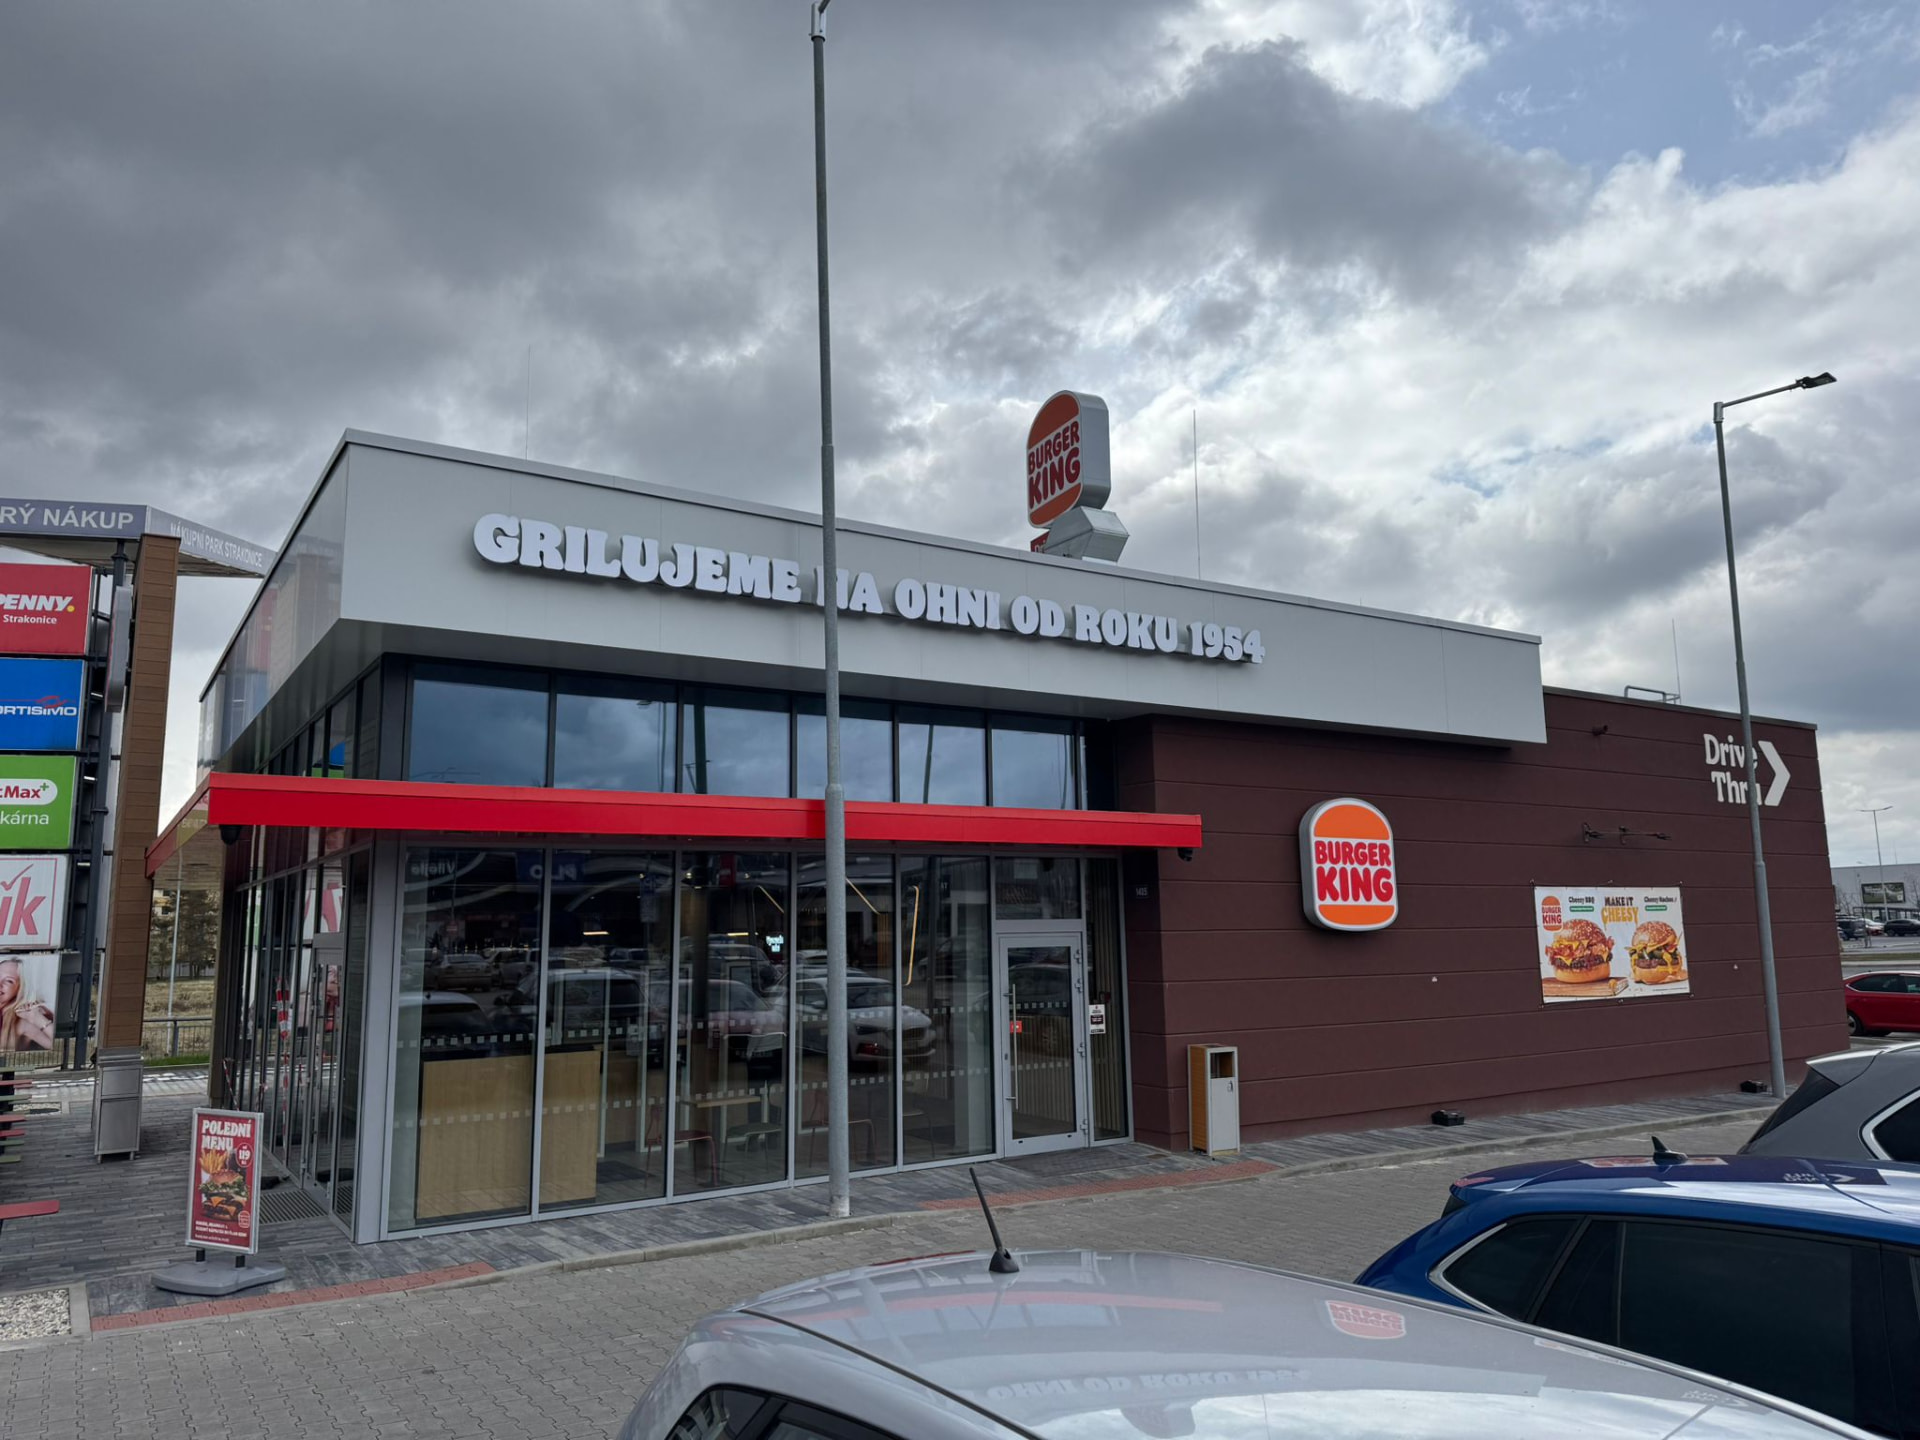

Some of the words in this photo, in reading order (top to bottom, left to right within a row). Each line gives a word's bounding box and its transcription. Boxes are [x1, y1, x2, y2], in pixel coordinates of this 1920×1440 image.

[1028, 420, 1080, 475] BURGER
[1028, 446, 1081, 510] KING
[43, 505, 134, 530] NÁKUP
[205, 535, 225, 556] PARK
[473, 513, 802, 603] GRILUJEME
[894, 578, 1001, 630] OHNI
[1011, 595, 1066, 638] OD
[1074, 604, 1178, 653] ROKU
[1187, 621, 1266, 664] 1954
[3, 614, 58, 625] Strakonice
[0, 705, 77, 717] RTISIMO
[1314, 840, 1392, 867] BURGER
[1316, 866, 1394, 902] KING
[1604, 896, 1626, 906] MAKE
[1626, 896, 1634, 906] IT
[1542, 914, 1563, 924] KING
[1601, 907, 1639, 925] CHEESY
[202, 1119, 252, 1138] POLEDNÍ
[201, 1135, 234, 1152] MENU
[239, 1149, 251, 1160] 119
